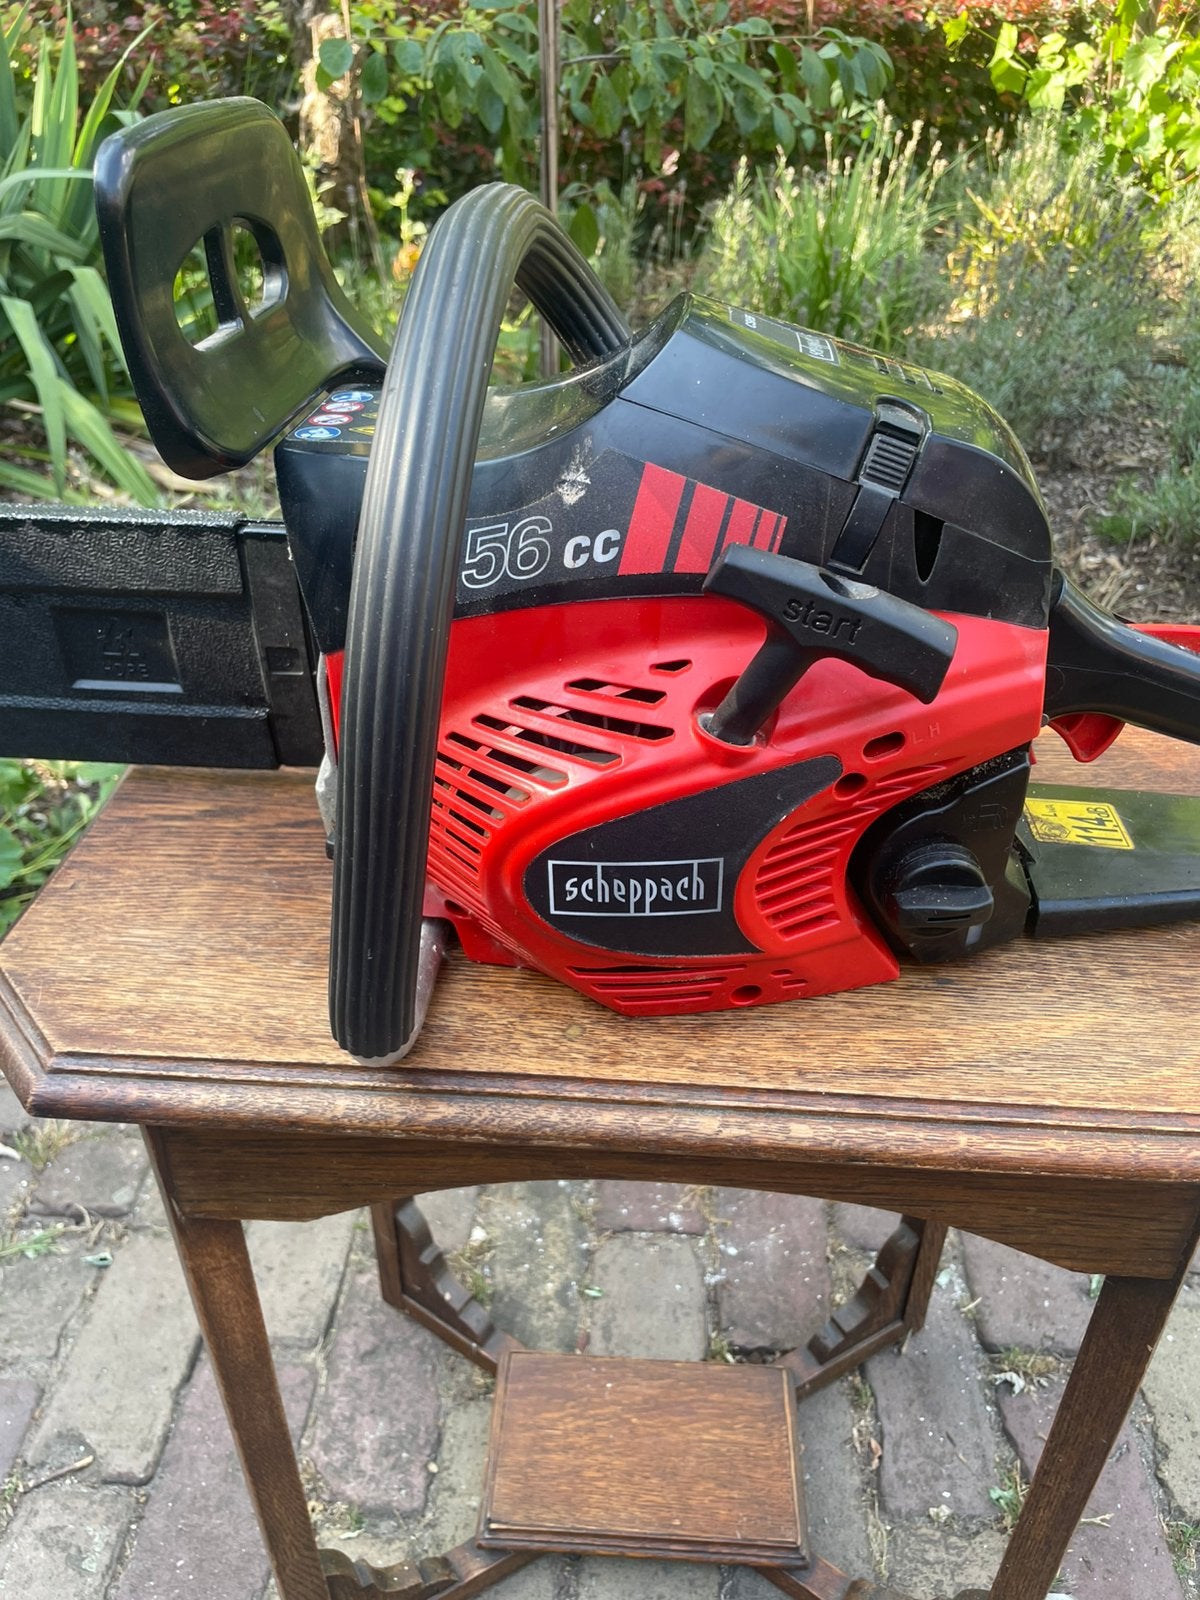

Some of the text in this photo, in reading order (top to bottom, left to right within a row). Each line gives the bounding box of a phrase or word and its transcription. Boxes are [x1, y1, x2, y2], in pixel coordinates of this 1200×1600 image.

[461, 515, 553, 589] 56
[782, 598, 863, 645] start
[564, 862, 706, 916] scheppach
